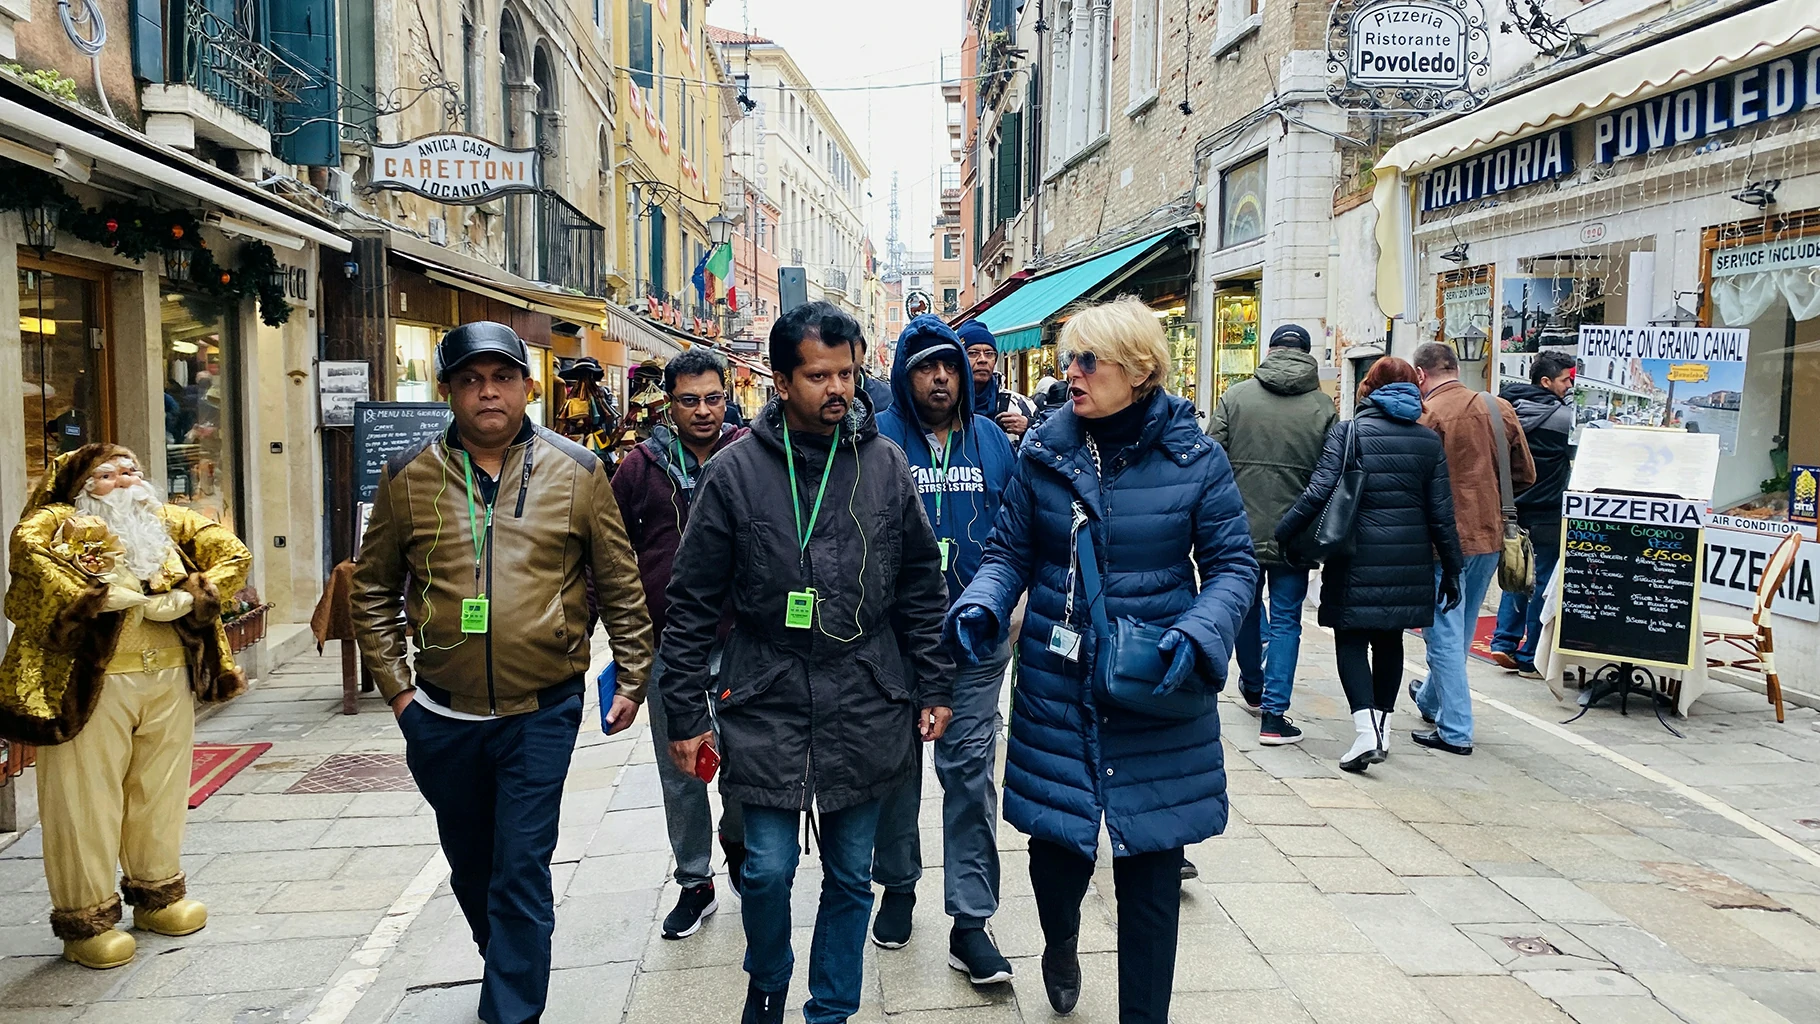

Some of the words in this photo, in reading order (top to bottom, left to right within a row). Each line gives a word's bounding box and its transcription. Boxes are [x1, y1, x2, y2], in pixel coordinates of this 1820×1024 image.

[1374, 10, 1443, 29] Pizzeria
[1365, 32, 1451, 46] Ristorante
[1360, 50, 1456, 73] Povoledo
[418, 138, 457, 158] ANTICA
[463, 139, 491, 159] CASA
[384, 157, 524, 181] CARETTONI
[1420, 131, 1562, 211] TRATTORIA
[421, 179, 490, 198] LOCANDA
[1716, 250, 1765, 270] SERVICE
[1582, 328, 1634, 357] TERRACE
[1637, 329, 1655, 358] ON
[1658, 330, 1699, 359] GRAND
[1704, 331, 1743, 361] CANAL
[1565, 495, 1702, 525] PIZZERIA
[1630, 524, 1684, 540] GIORNO
[1712, 515, 1730, 526] AIR
[1735, 518, 1799, 534] CONDITION
[1567, 530, 1609, 543] CARNE
[1702, 543, 1816, 605] IZZEIA
